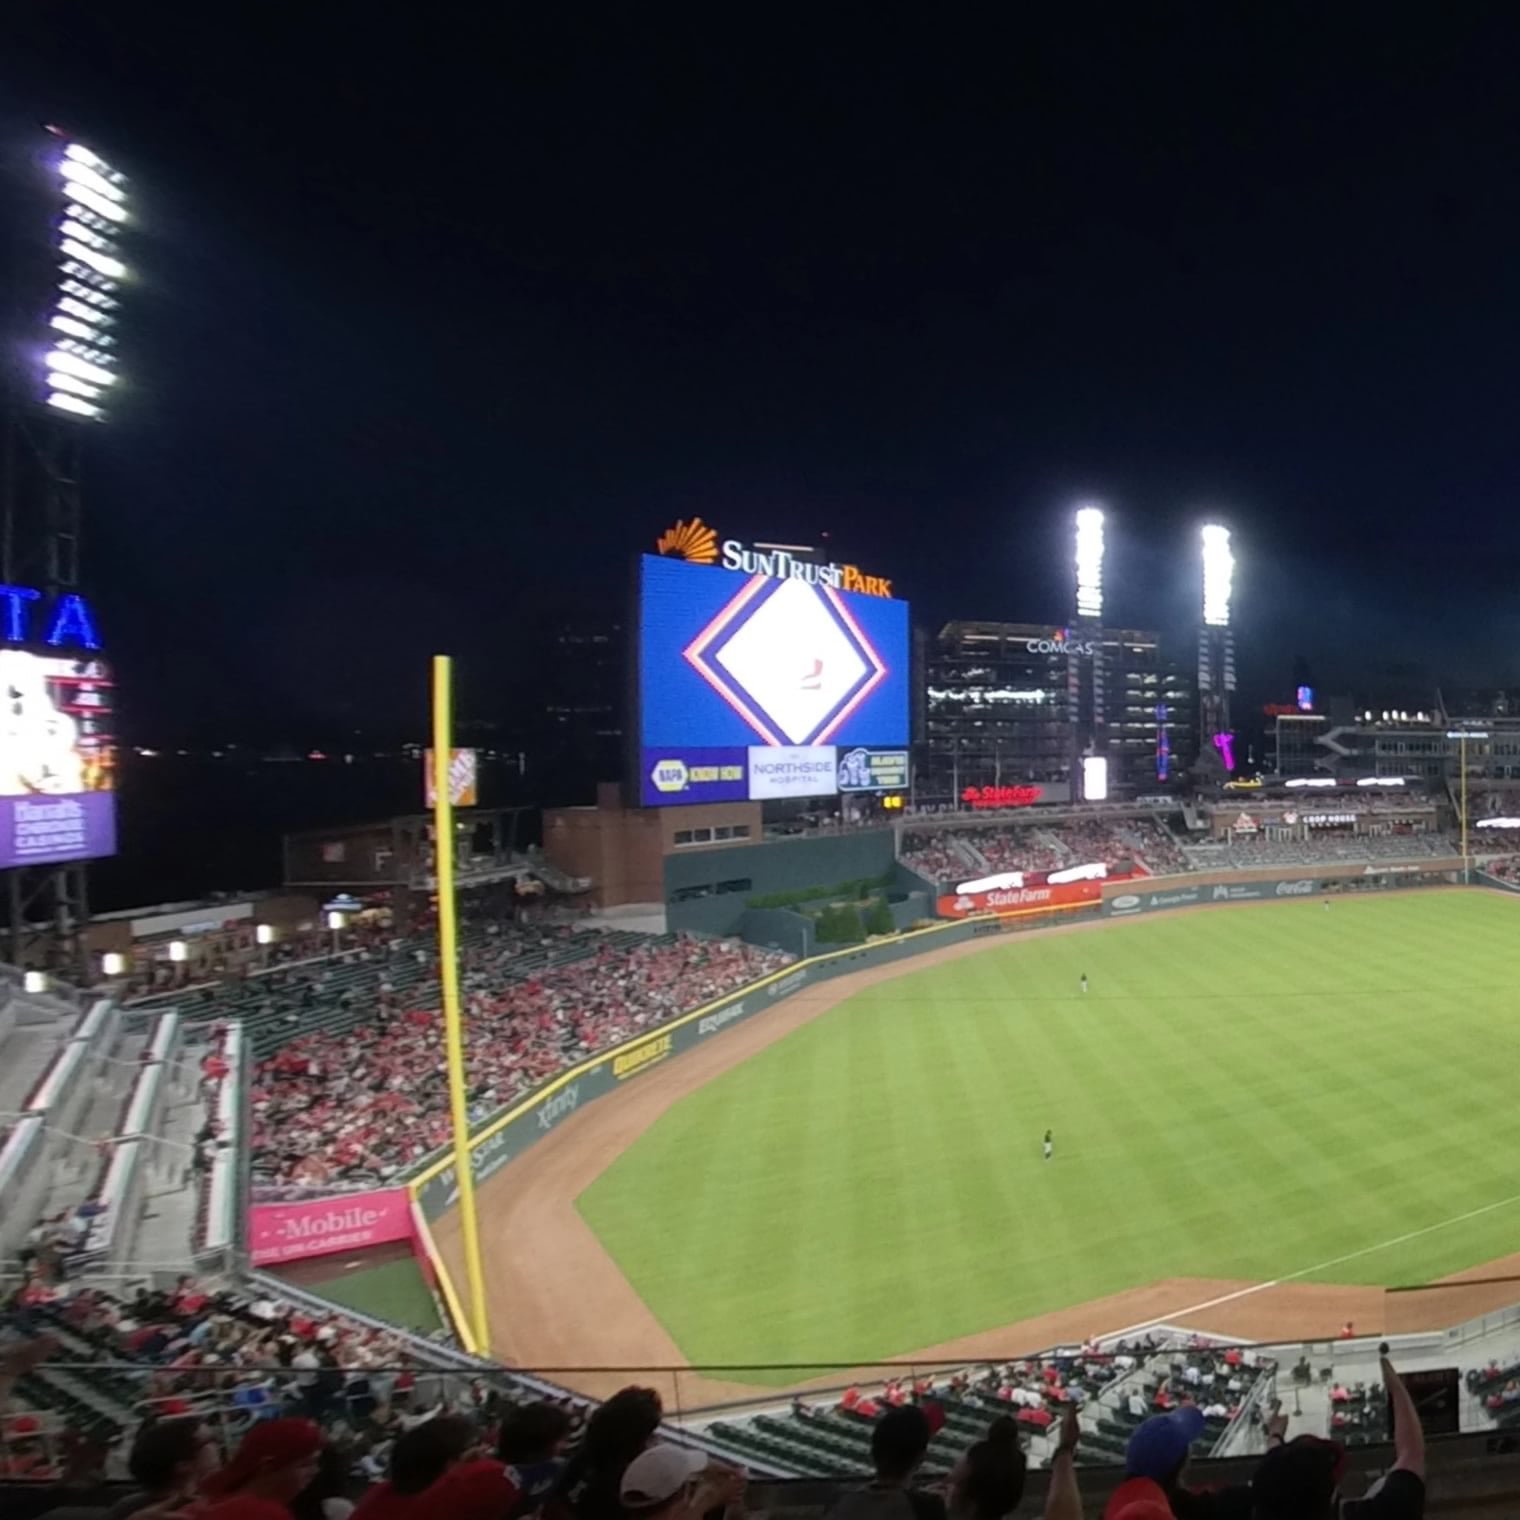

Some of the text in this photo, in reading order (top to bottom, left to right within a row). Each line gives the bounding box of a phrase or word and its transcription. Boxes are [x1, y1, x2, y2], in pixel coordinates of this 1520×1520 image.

[753, 761, 833, 774] NORTHSIDE
[658, 768, 682, 782] NAPA
[769, 775, 819, 785] HOSPITAL
[986, 888, 1051, 908] State Farm
